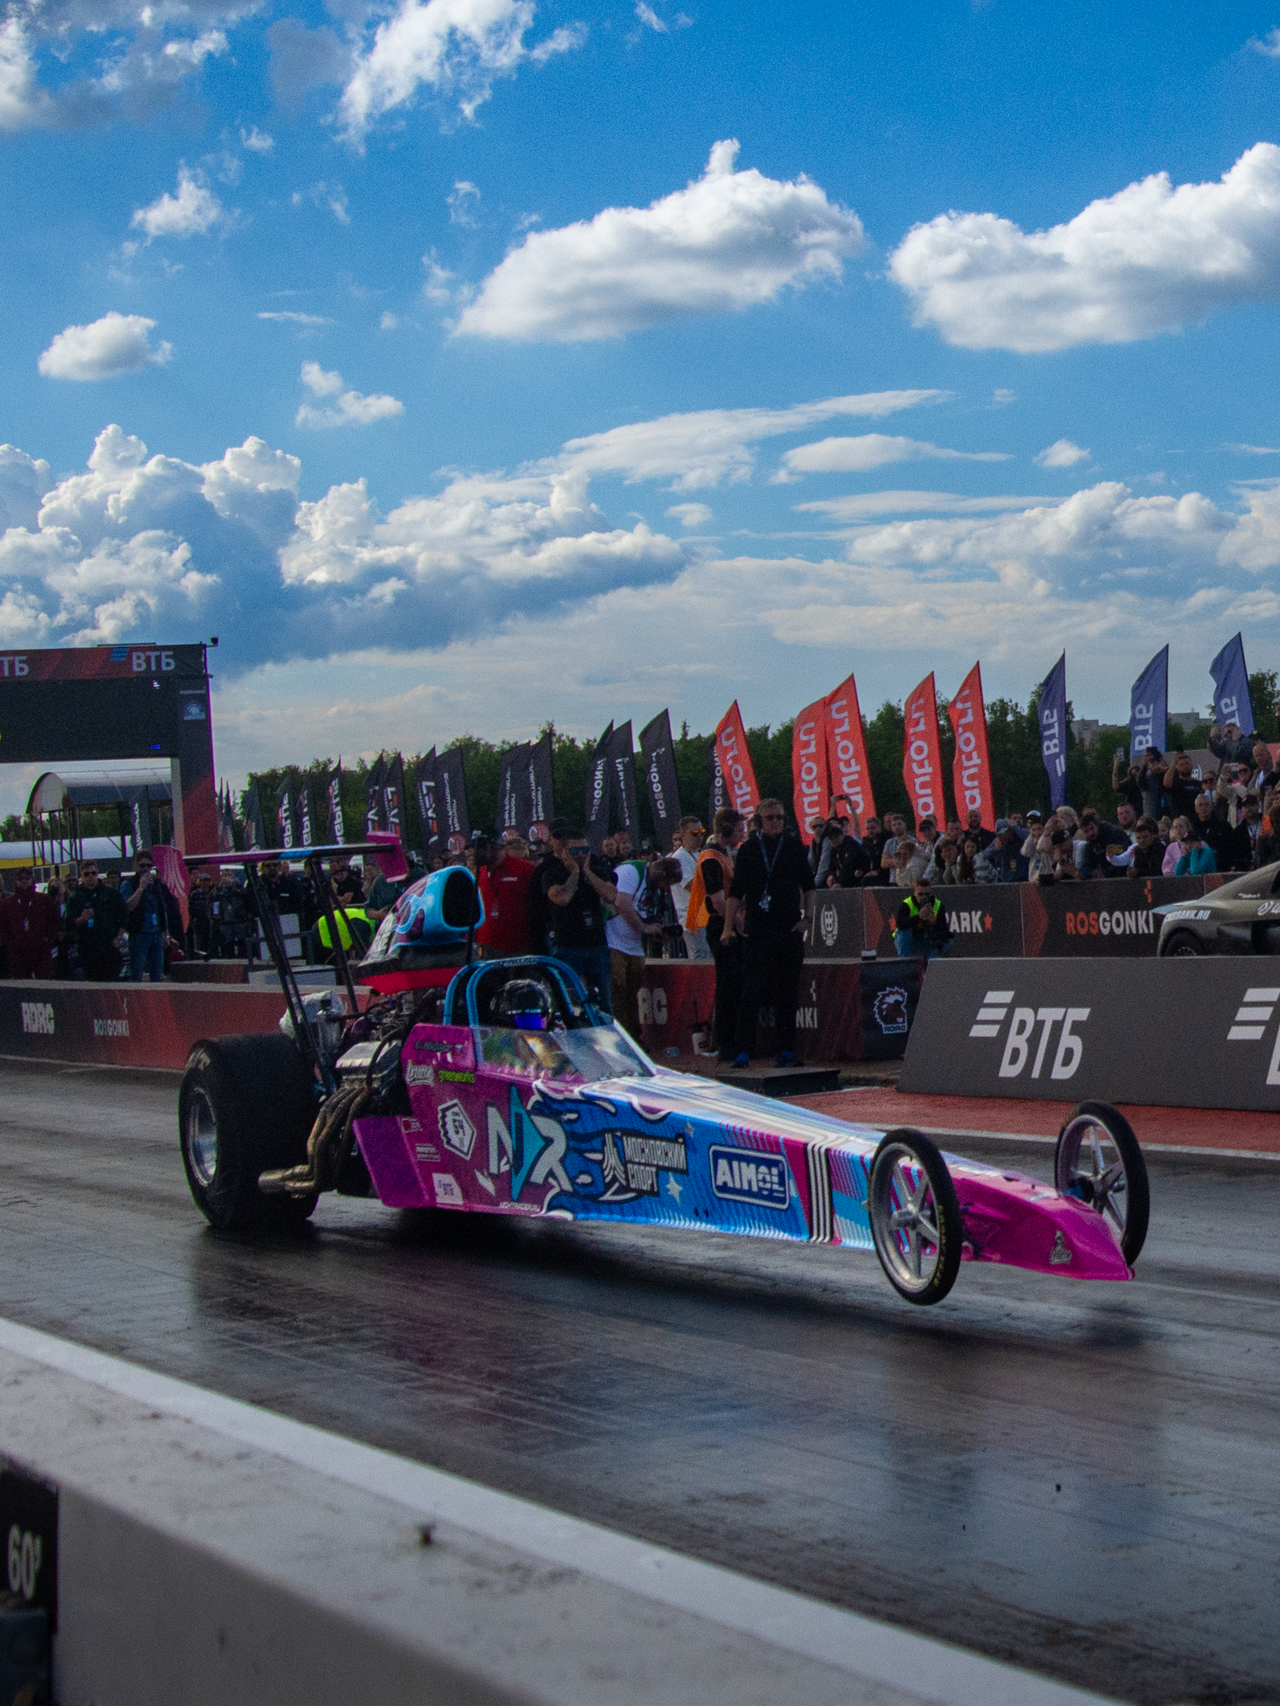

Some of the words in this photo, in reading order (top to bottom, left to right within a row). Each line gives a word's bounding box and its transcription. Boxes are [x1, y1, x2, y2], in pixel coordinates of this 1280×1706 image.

[131, 651, 175, 672] ВТБ
[1065, 910, 1154, 936] ROSGONKI
[999, 1006, 1091, 1079] ВТБ
[626, 1163, 658, 1192] СПОРТ
[716, 1158, 785, 1197] AIMOL
